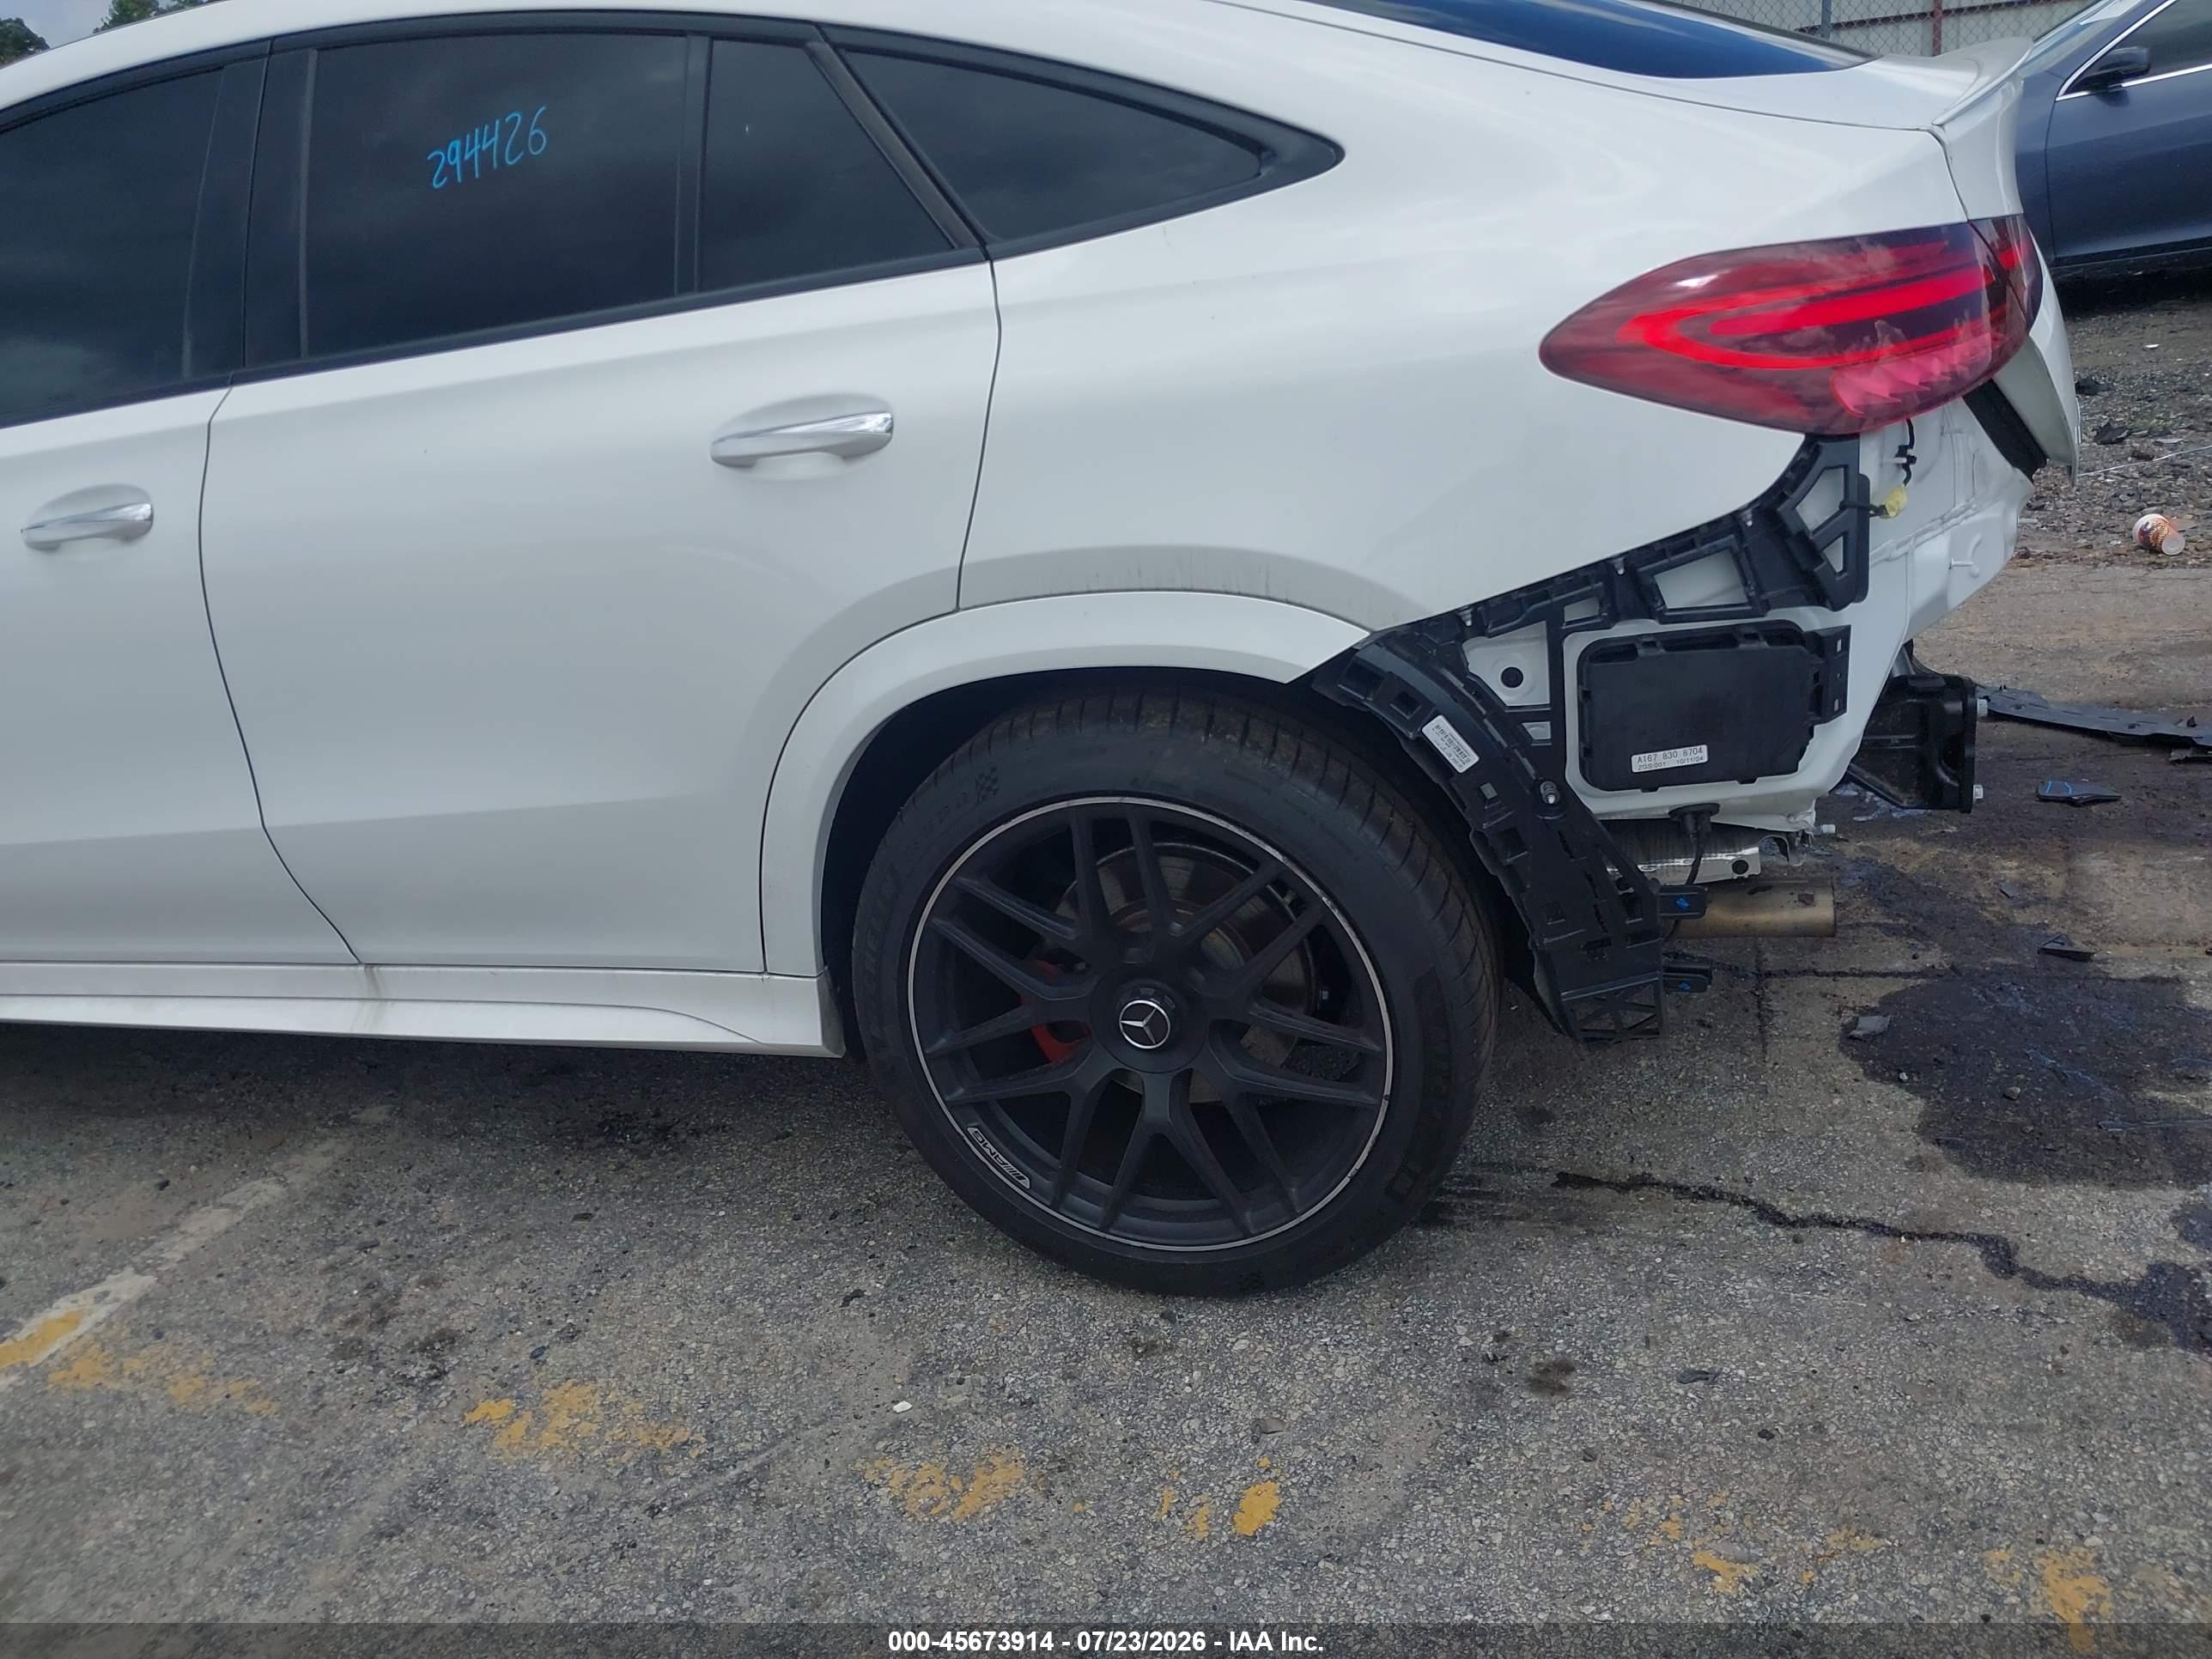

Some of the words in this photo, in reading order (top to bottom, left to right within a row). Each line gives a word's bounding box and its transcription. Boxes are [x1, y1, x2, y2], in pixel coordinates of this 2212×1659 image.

[427, 105, 547, 189] 294426
[1638, 754, 1657, 763] A167
[1662, 750, 1678, 760] 830
[1682, 746, 1704, 757] 8704
[974, 1130, 1009, 1166] AMG
